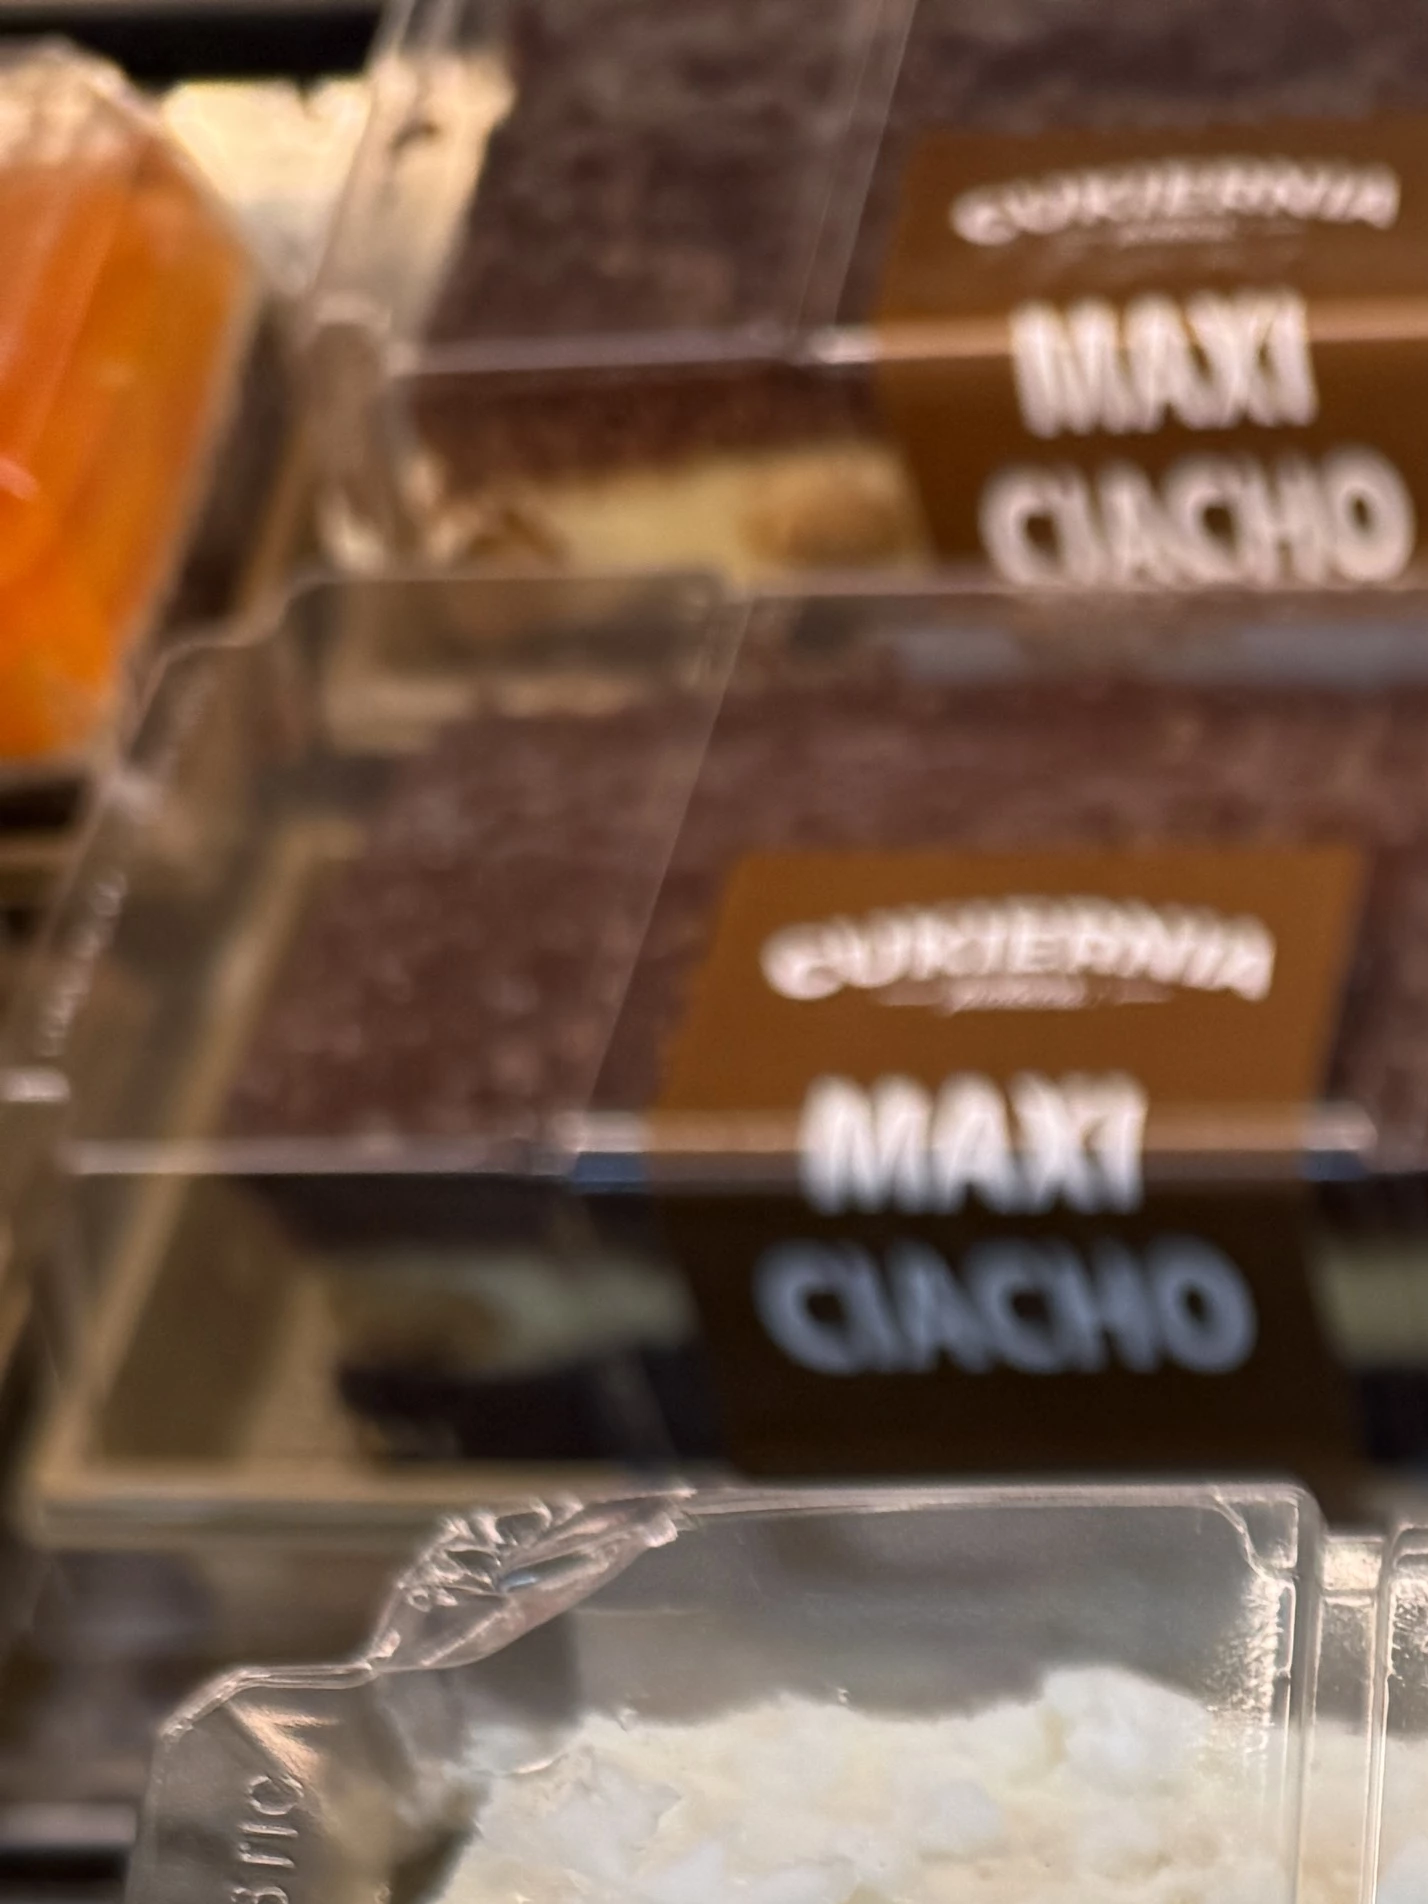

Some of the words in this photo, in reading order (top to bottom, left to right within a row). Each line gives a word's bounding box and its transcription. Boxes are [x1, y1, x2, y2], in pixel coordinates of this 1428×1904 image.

[1010, 293, 1320, 438] MAXI
[980, 450, 1412, 588] CIACHO
[762, 893, 1276, 1002] CUKIERNIA
[803, 1072, 1146, 1214] MAXI
[756, 1236, 1256, 1373] CIACHO
